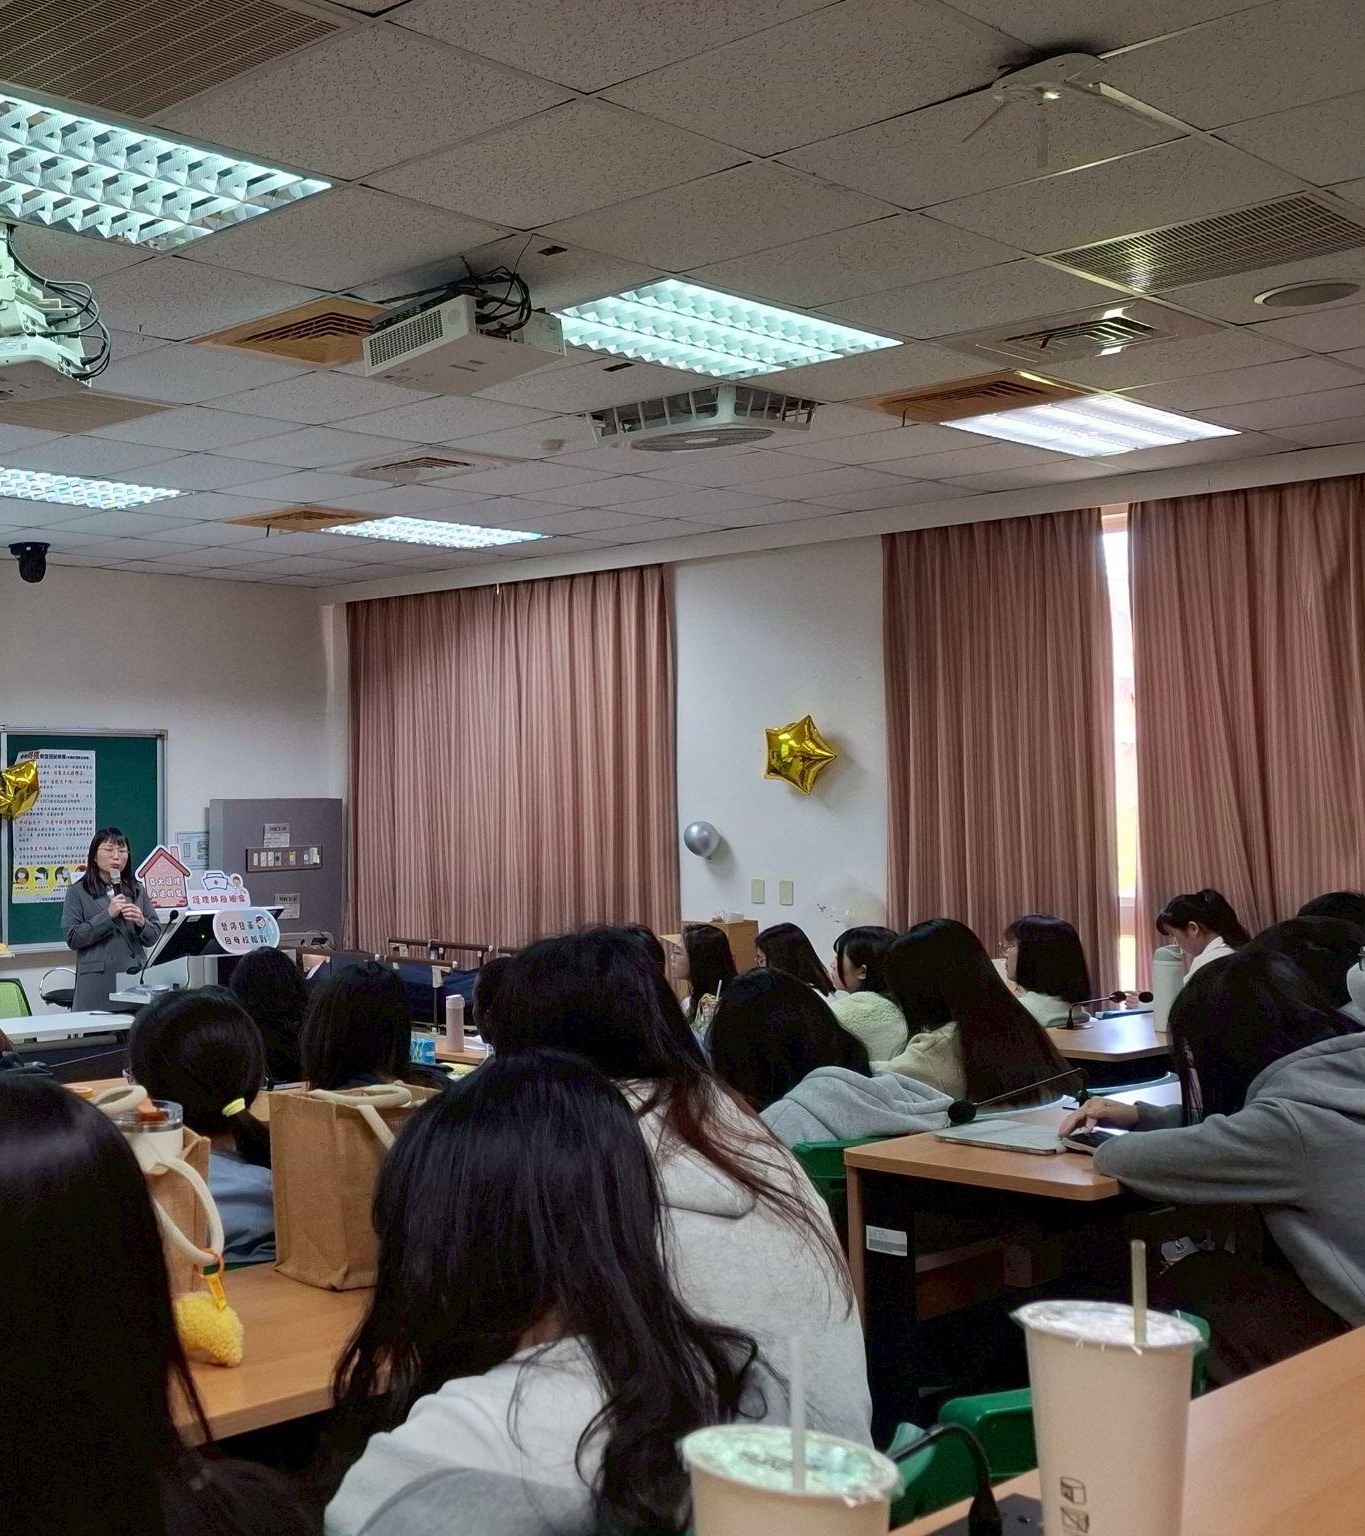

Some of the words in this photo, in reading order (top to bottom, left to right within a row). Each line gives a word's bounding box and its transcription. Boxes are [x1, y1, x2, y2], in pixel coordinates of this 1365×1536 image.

[150, 888, 183, 899] 永遠的家
[192, 894, 246, 904] 護理師回娘家
[224, 935, 268, 945] 回母校報到
